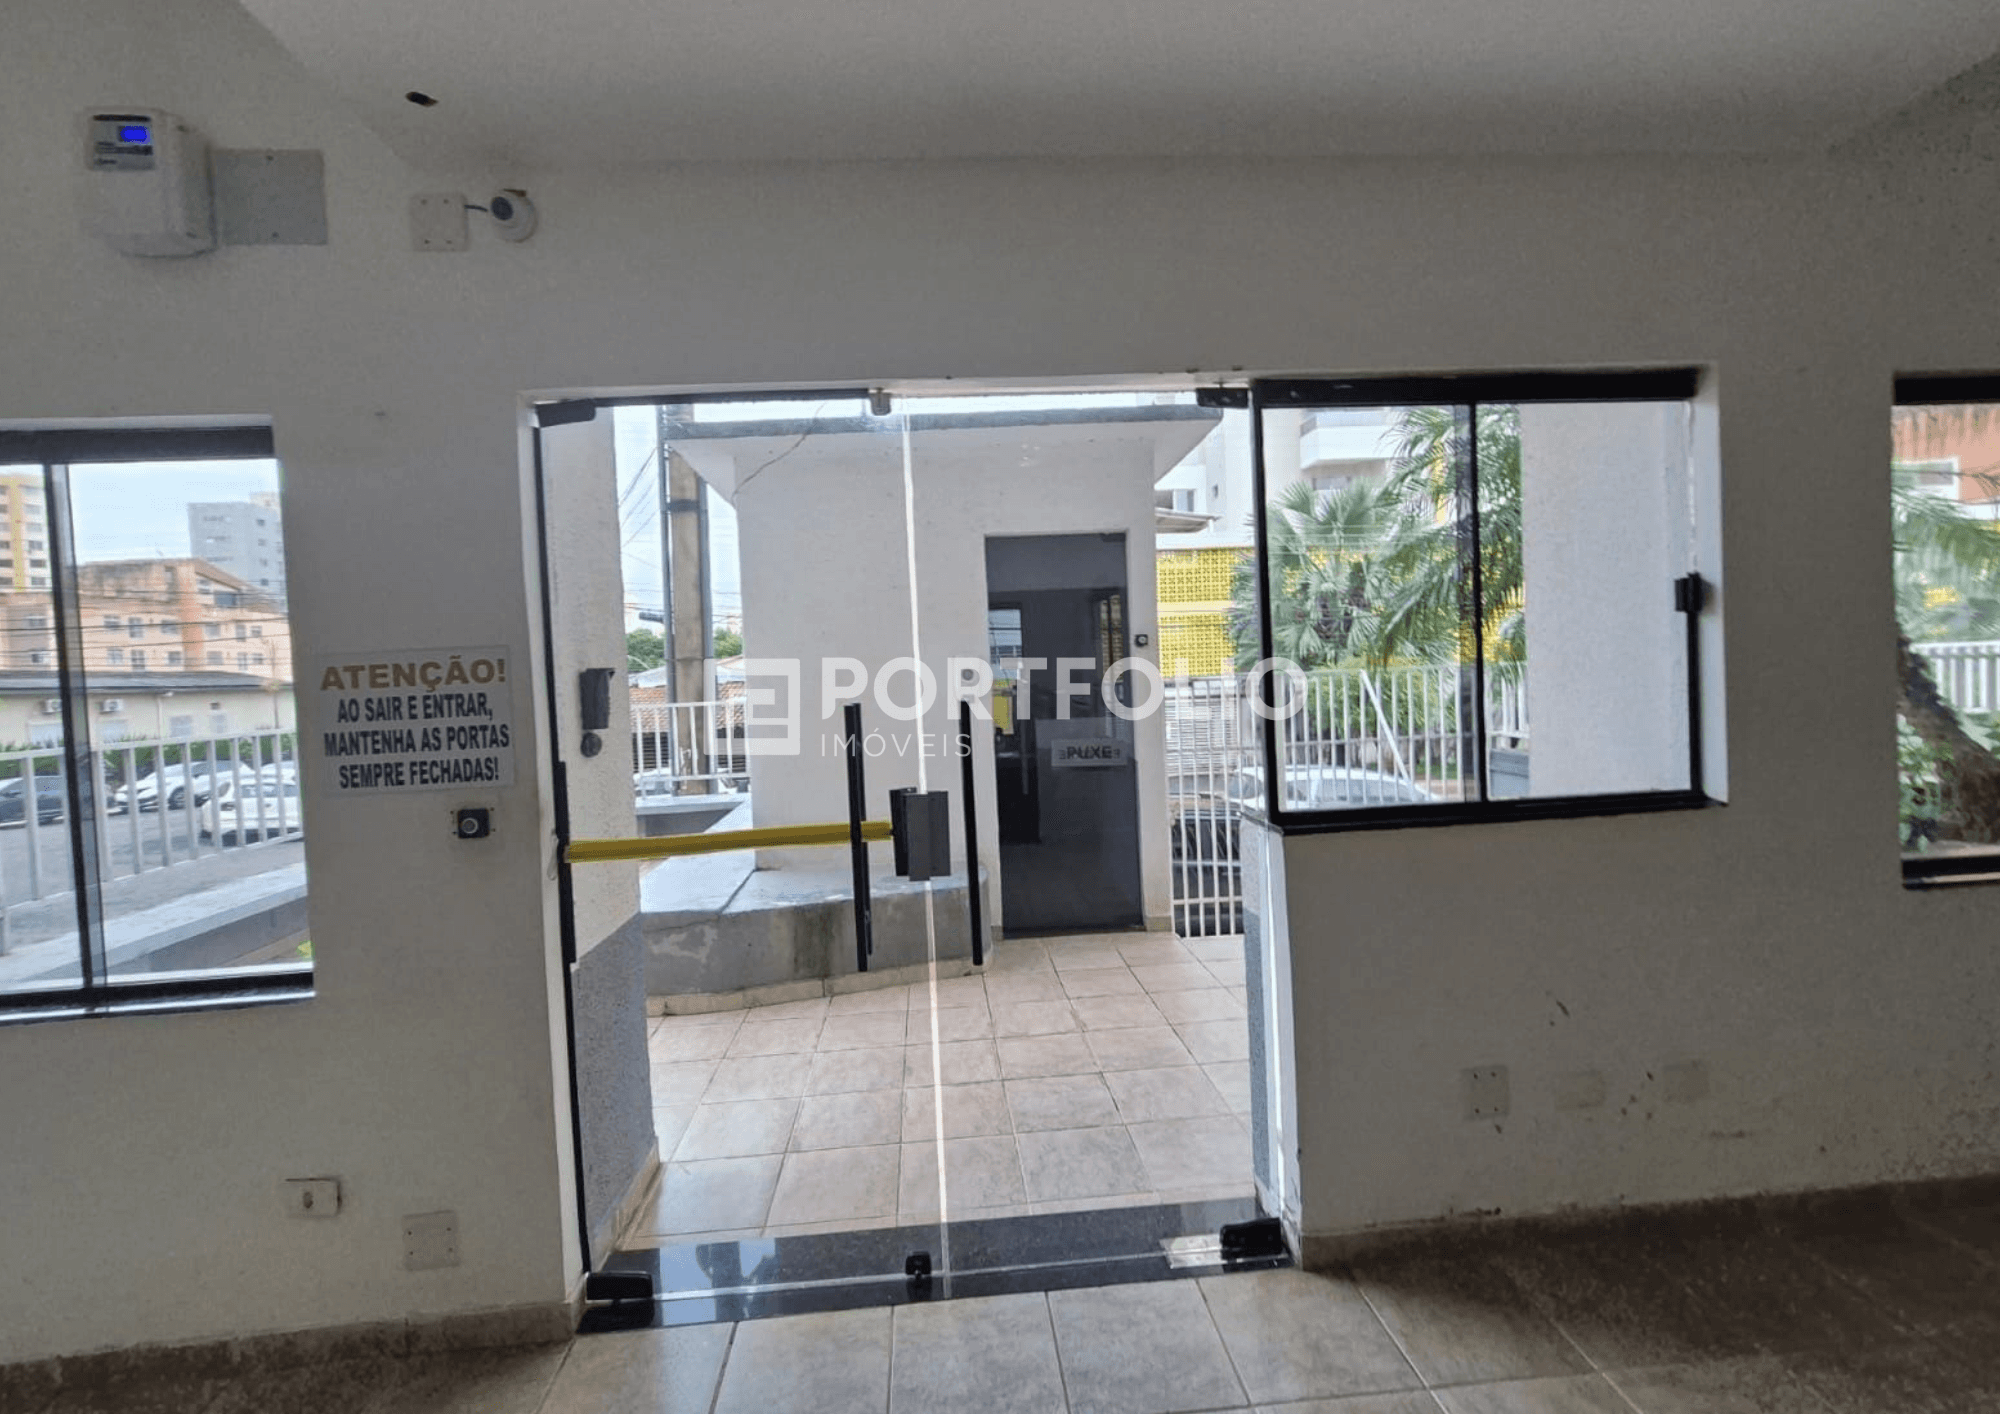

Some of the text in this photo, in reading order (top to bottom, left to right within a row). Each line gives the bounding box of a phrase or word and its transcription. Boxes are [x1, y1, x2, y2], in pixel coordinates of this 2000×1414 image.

[320, 655, 506, 692] ATENÇÃO!
[338, 692, 493, 723] AO SAIR E ENTRAR,
[324, 724, 509, 756] MANTENHA AS PORTAS
[1066, 745, 1113, 760] PUXE
[339, 756, 499, 789] SEMPRE FECHADAS!
